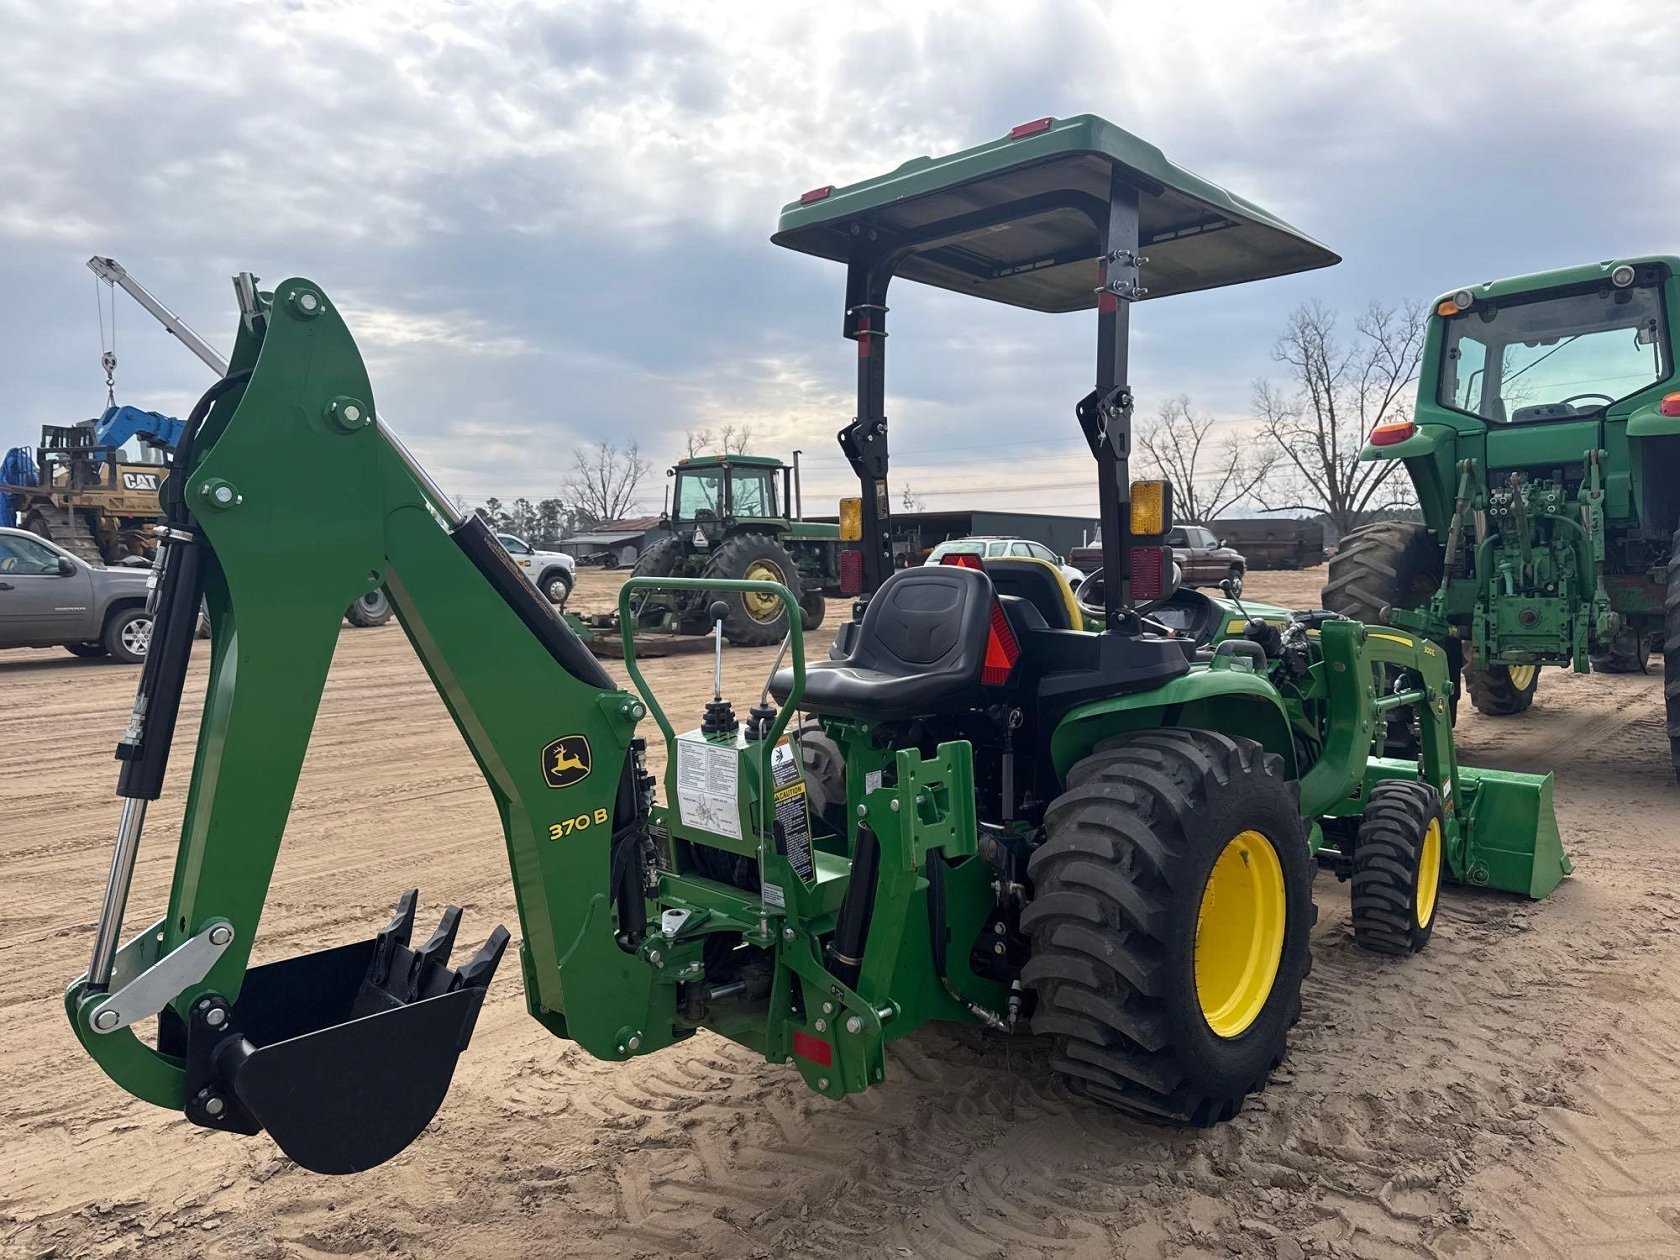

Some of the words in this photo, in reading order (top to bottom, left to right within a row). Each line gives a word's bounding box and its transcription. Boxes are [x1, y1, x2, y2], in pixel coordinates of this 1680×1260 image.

[123, 473, 157, 490] CAT
[779, 785, 802, 800] CAUTION
[548, 814, 591, 841] 370
[593, 808, 609, 825] B
